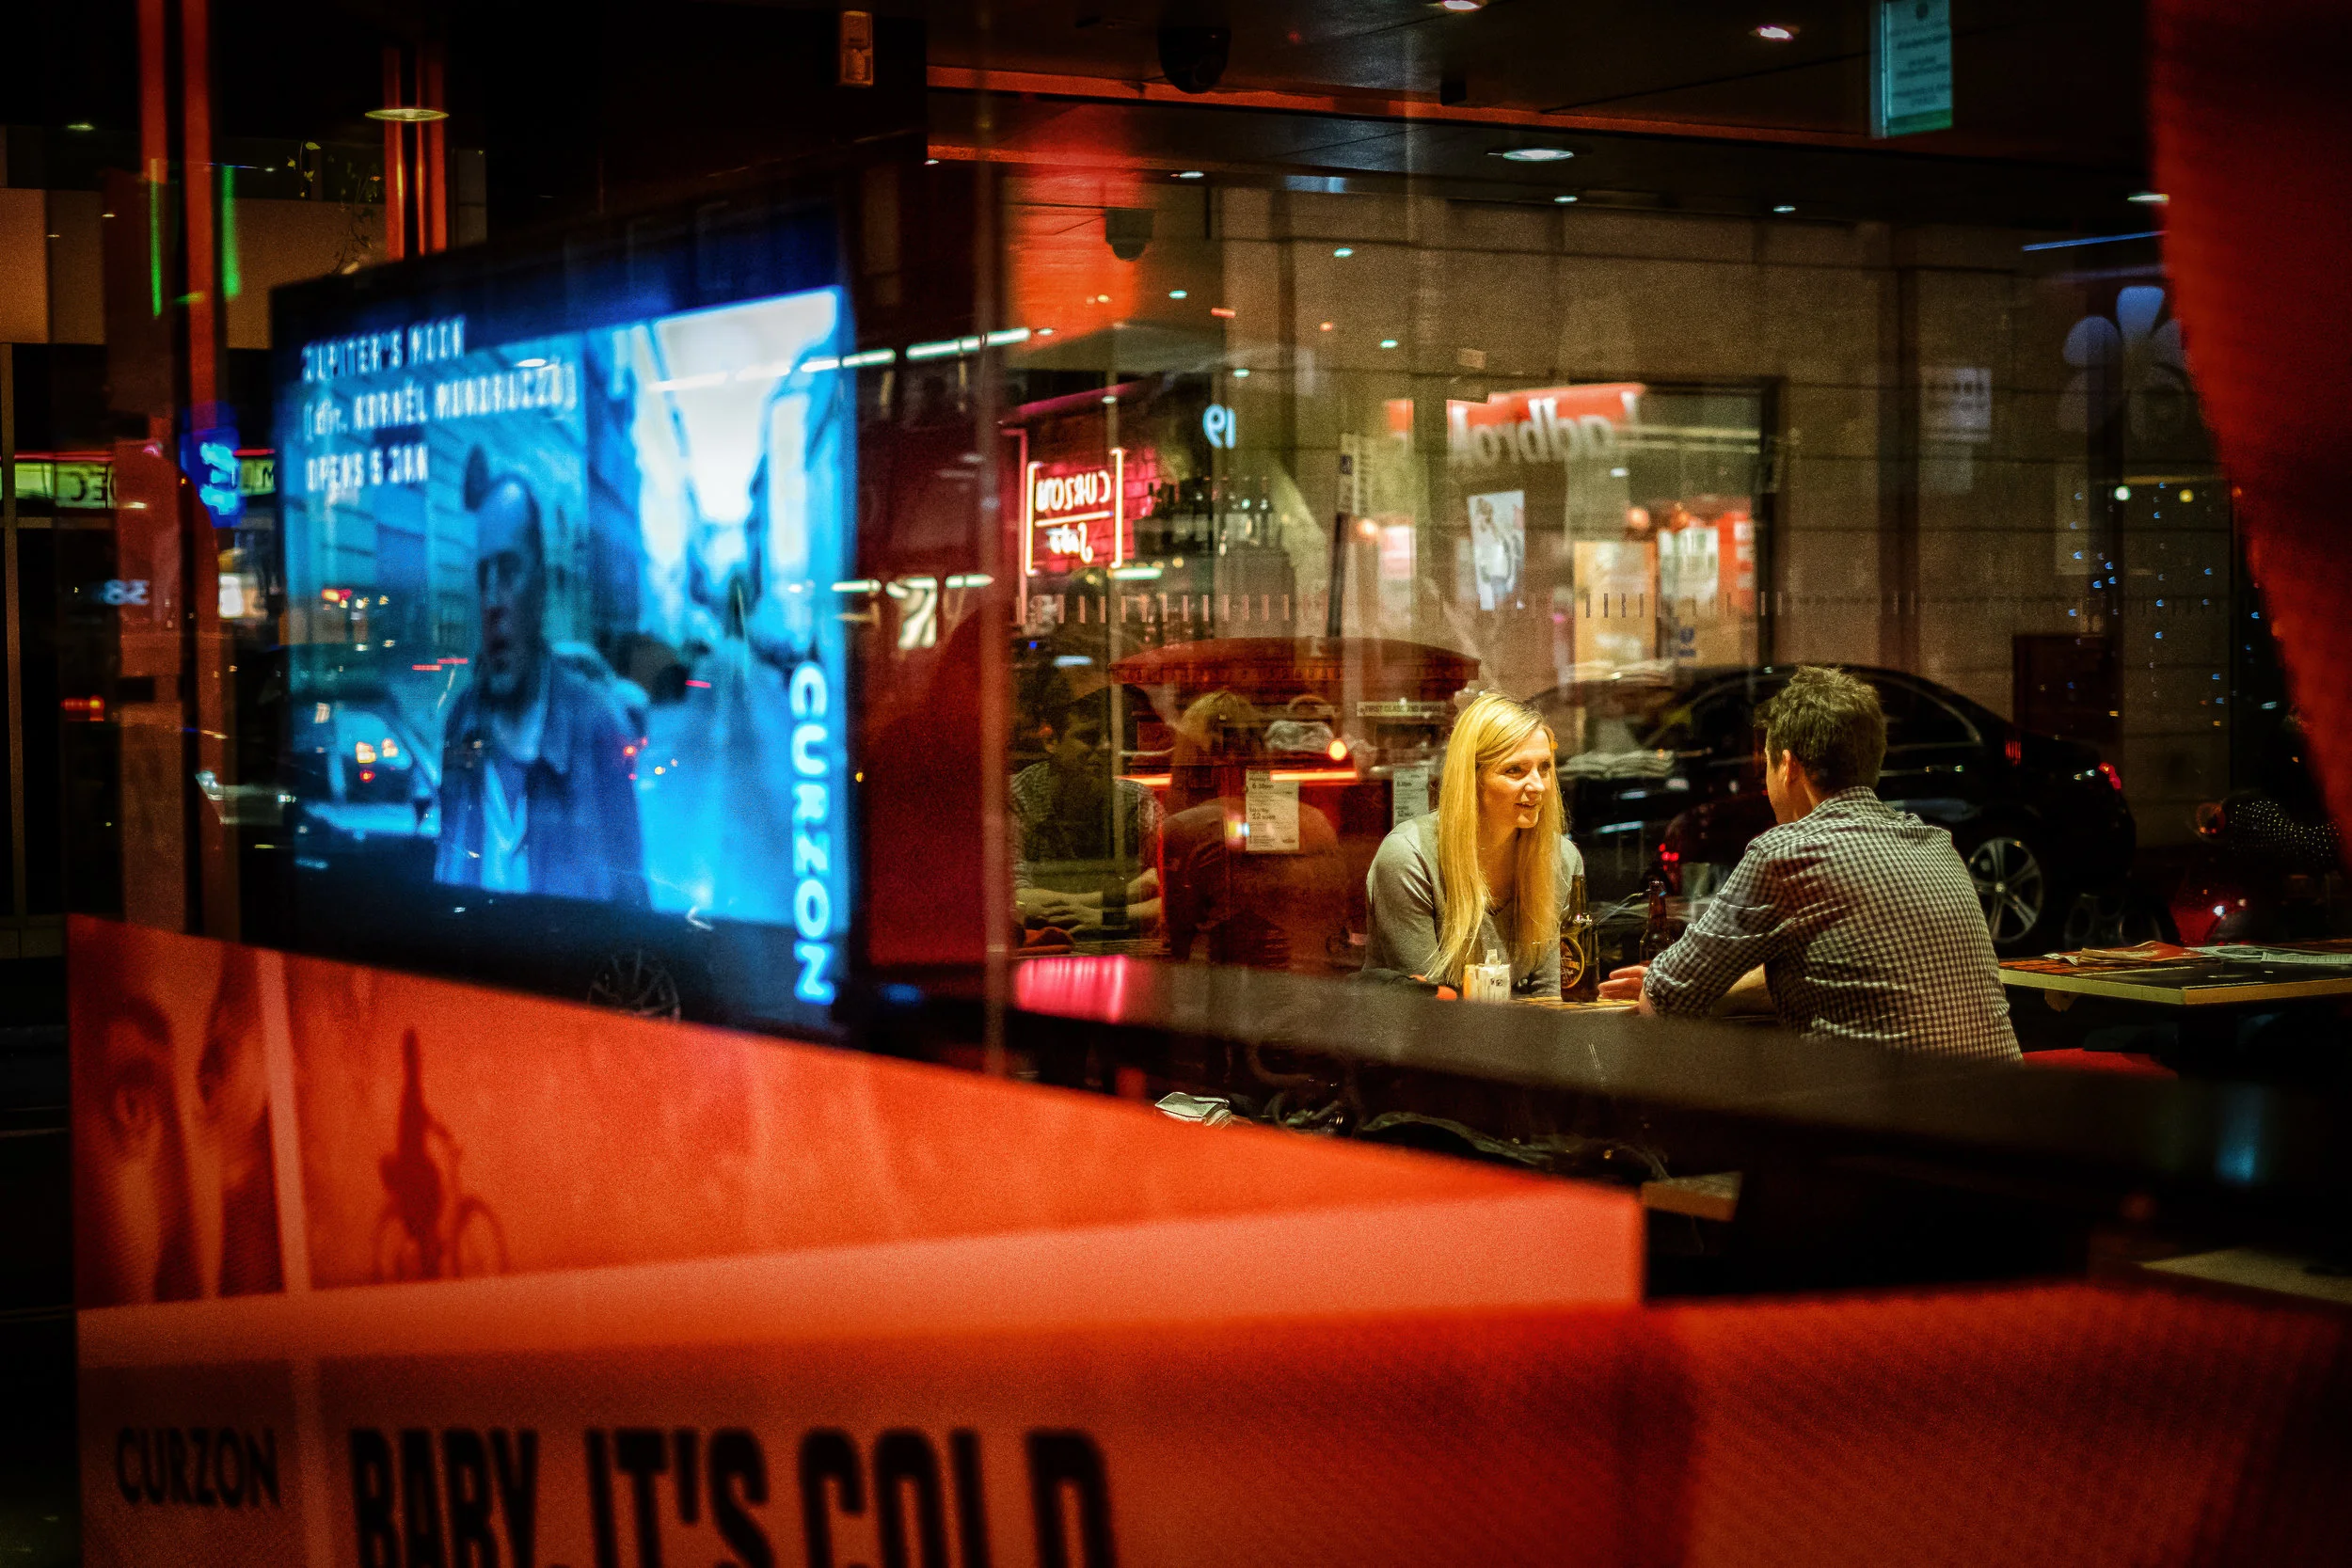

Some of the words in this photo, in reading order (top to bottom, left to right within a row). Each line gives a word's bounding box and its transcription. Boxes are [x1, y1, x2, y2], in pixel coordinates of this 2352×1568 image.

[789, 660, 835, 1006] CURZON
[116, 1424, 279, 1507] CURZON
[349, 1426, 566, 1568] BABY
[584, 1426, 780, 1568] IT'S
[799, 1426, 1120, 1568] COLD
